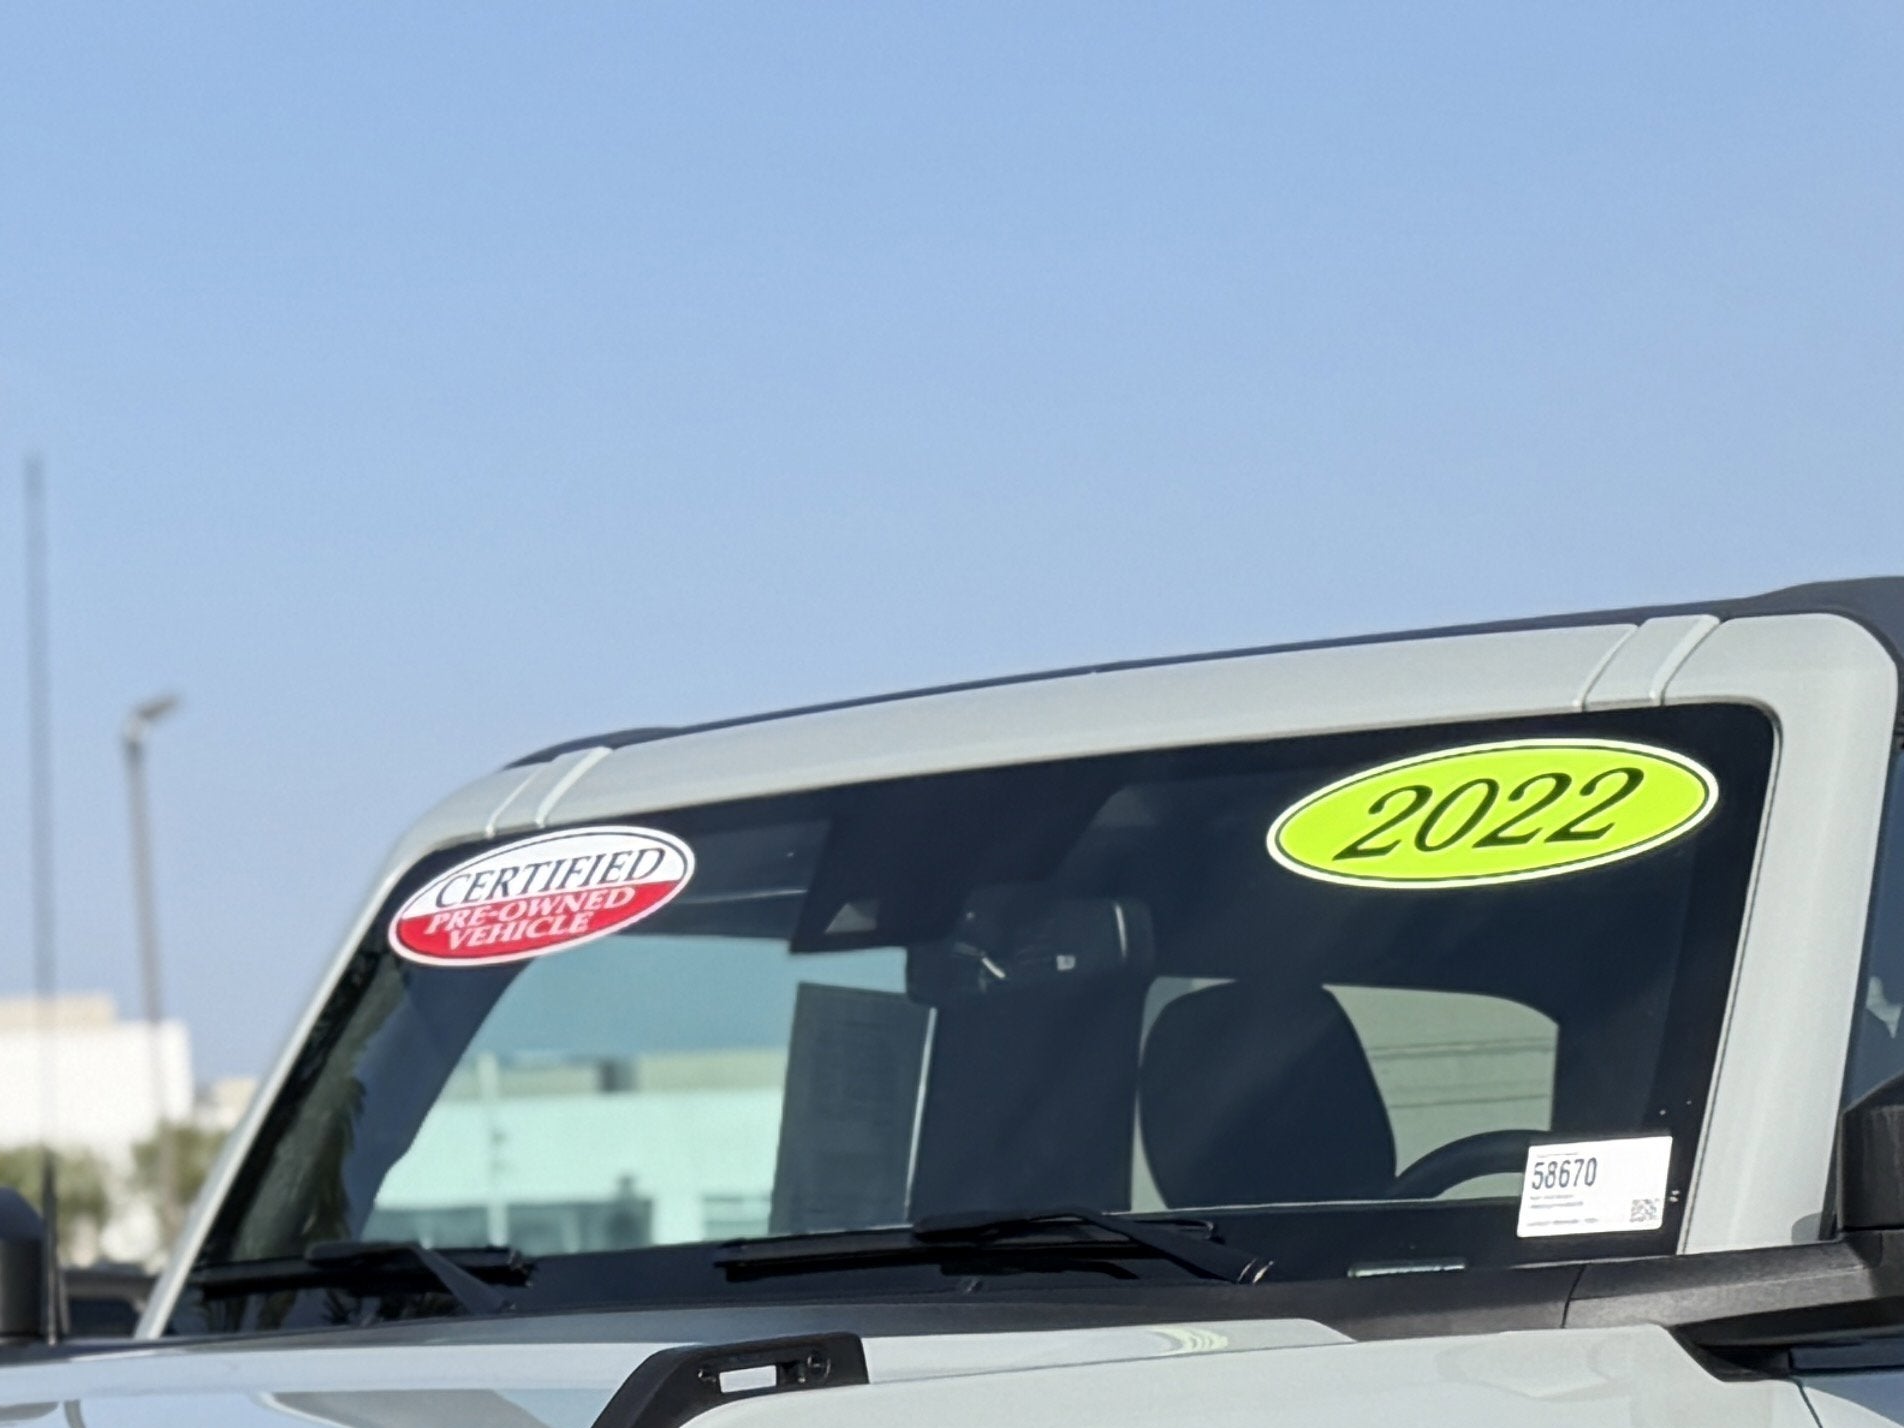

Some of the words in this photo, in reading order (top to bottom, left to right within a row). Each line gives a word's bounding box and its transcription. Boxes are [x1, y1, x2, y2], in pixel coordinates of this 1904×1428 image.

[1332, 767, 1645, 862] 2022
[434, 847, 666, 909] CERTIFIED
[423, 886, 637, 935] PRE-OWNED
[448, 911, 595, 951] VEHICLE
[1531, 1156, 1598, 1190] 58670
